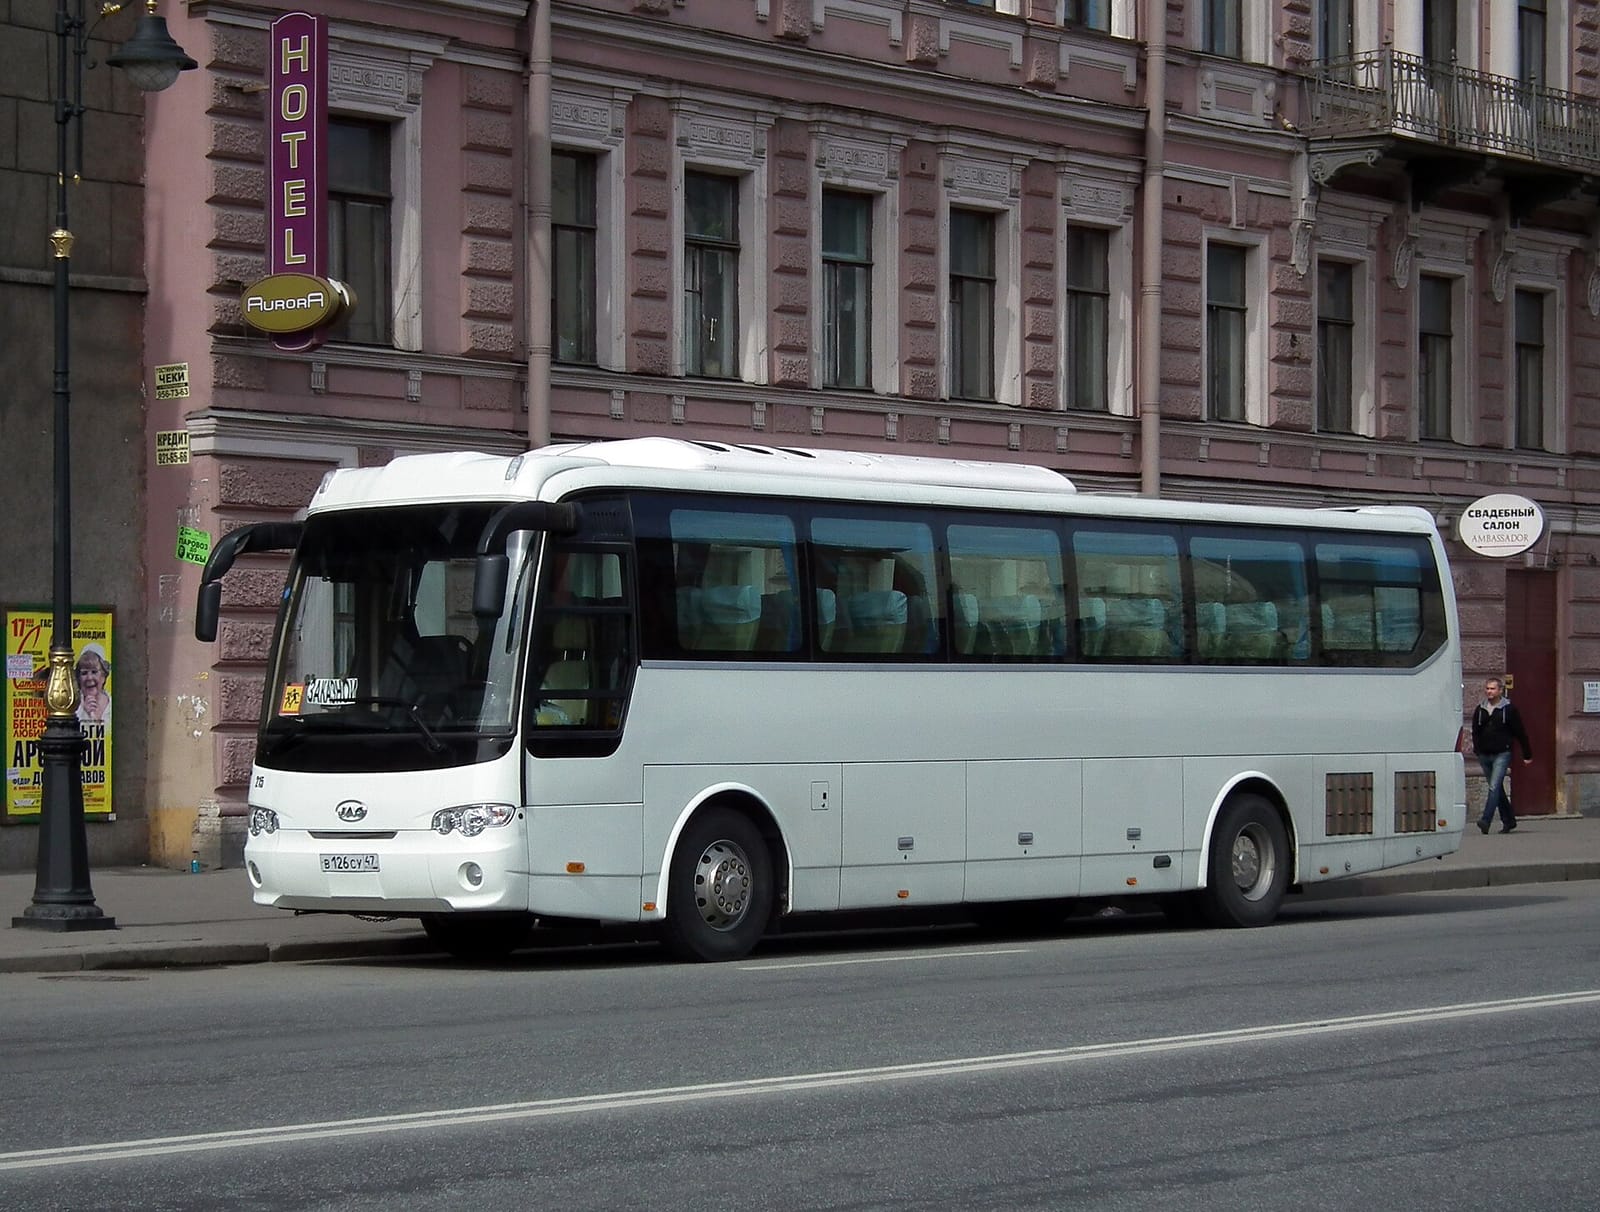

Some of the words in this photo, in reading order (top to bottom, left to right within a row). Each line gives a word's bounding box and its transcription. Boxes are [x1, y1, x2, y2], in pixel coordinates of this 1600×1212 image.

[281, 35, 309, 265] HOTEL
[158, 371, 185, 384] ЧЕКИ
[157, 432, 188, 448] КРЕДИТ
[1468, 507, 1535, 519] СВАДЕБНЫЙ
[1483, 521, 1520, 530] САЛОН
[178, 538, 208, 550] ПАРОВОЗ
[1472, 533, 1529, 543] AMBASSADOR
[186, 552, 207, 563] КУБЫ
[11, 618, 26, 637] 17
[13, 719, 47, 729] БЕНЕФ
